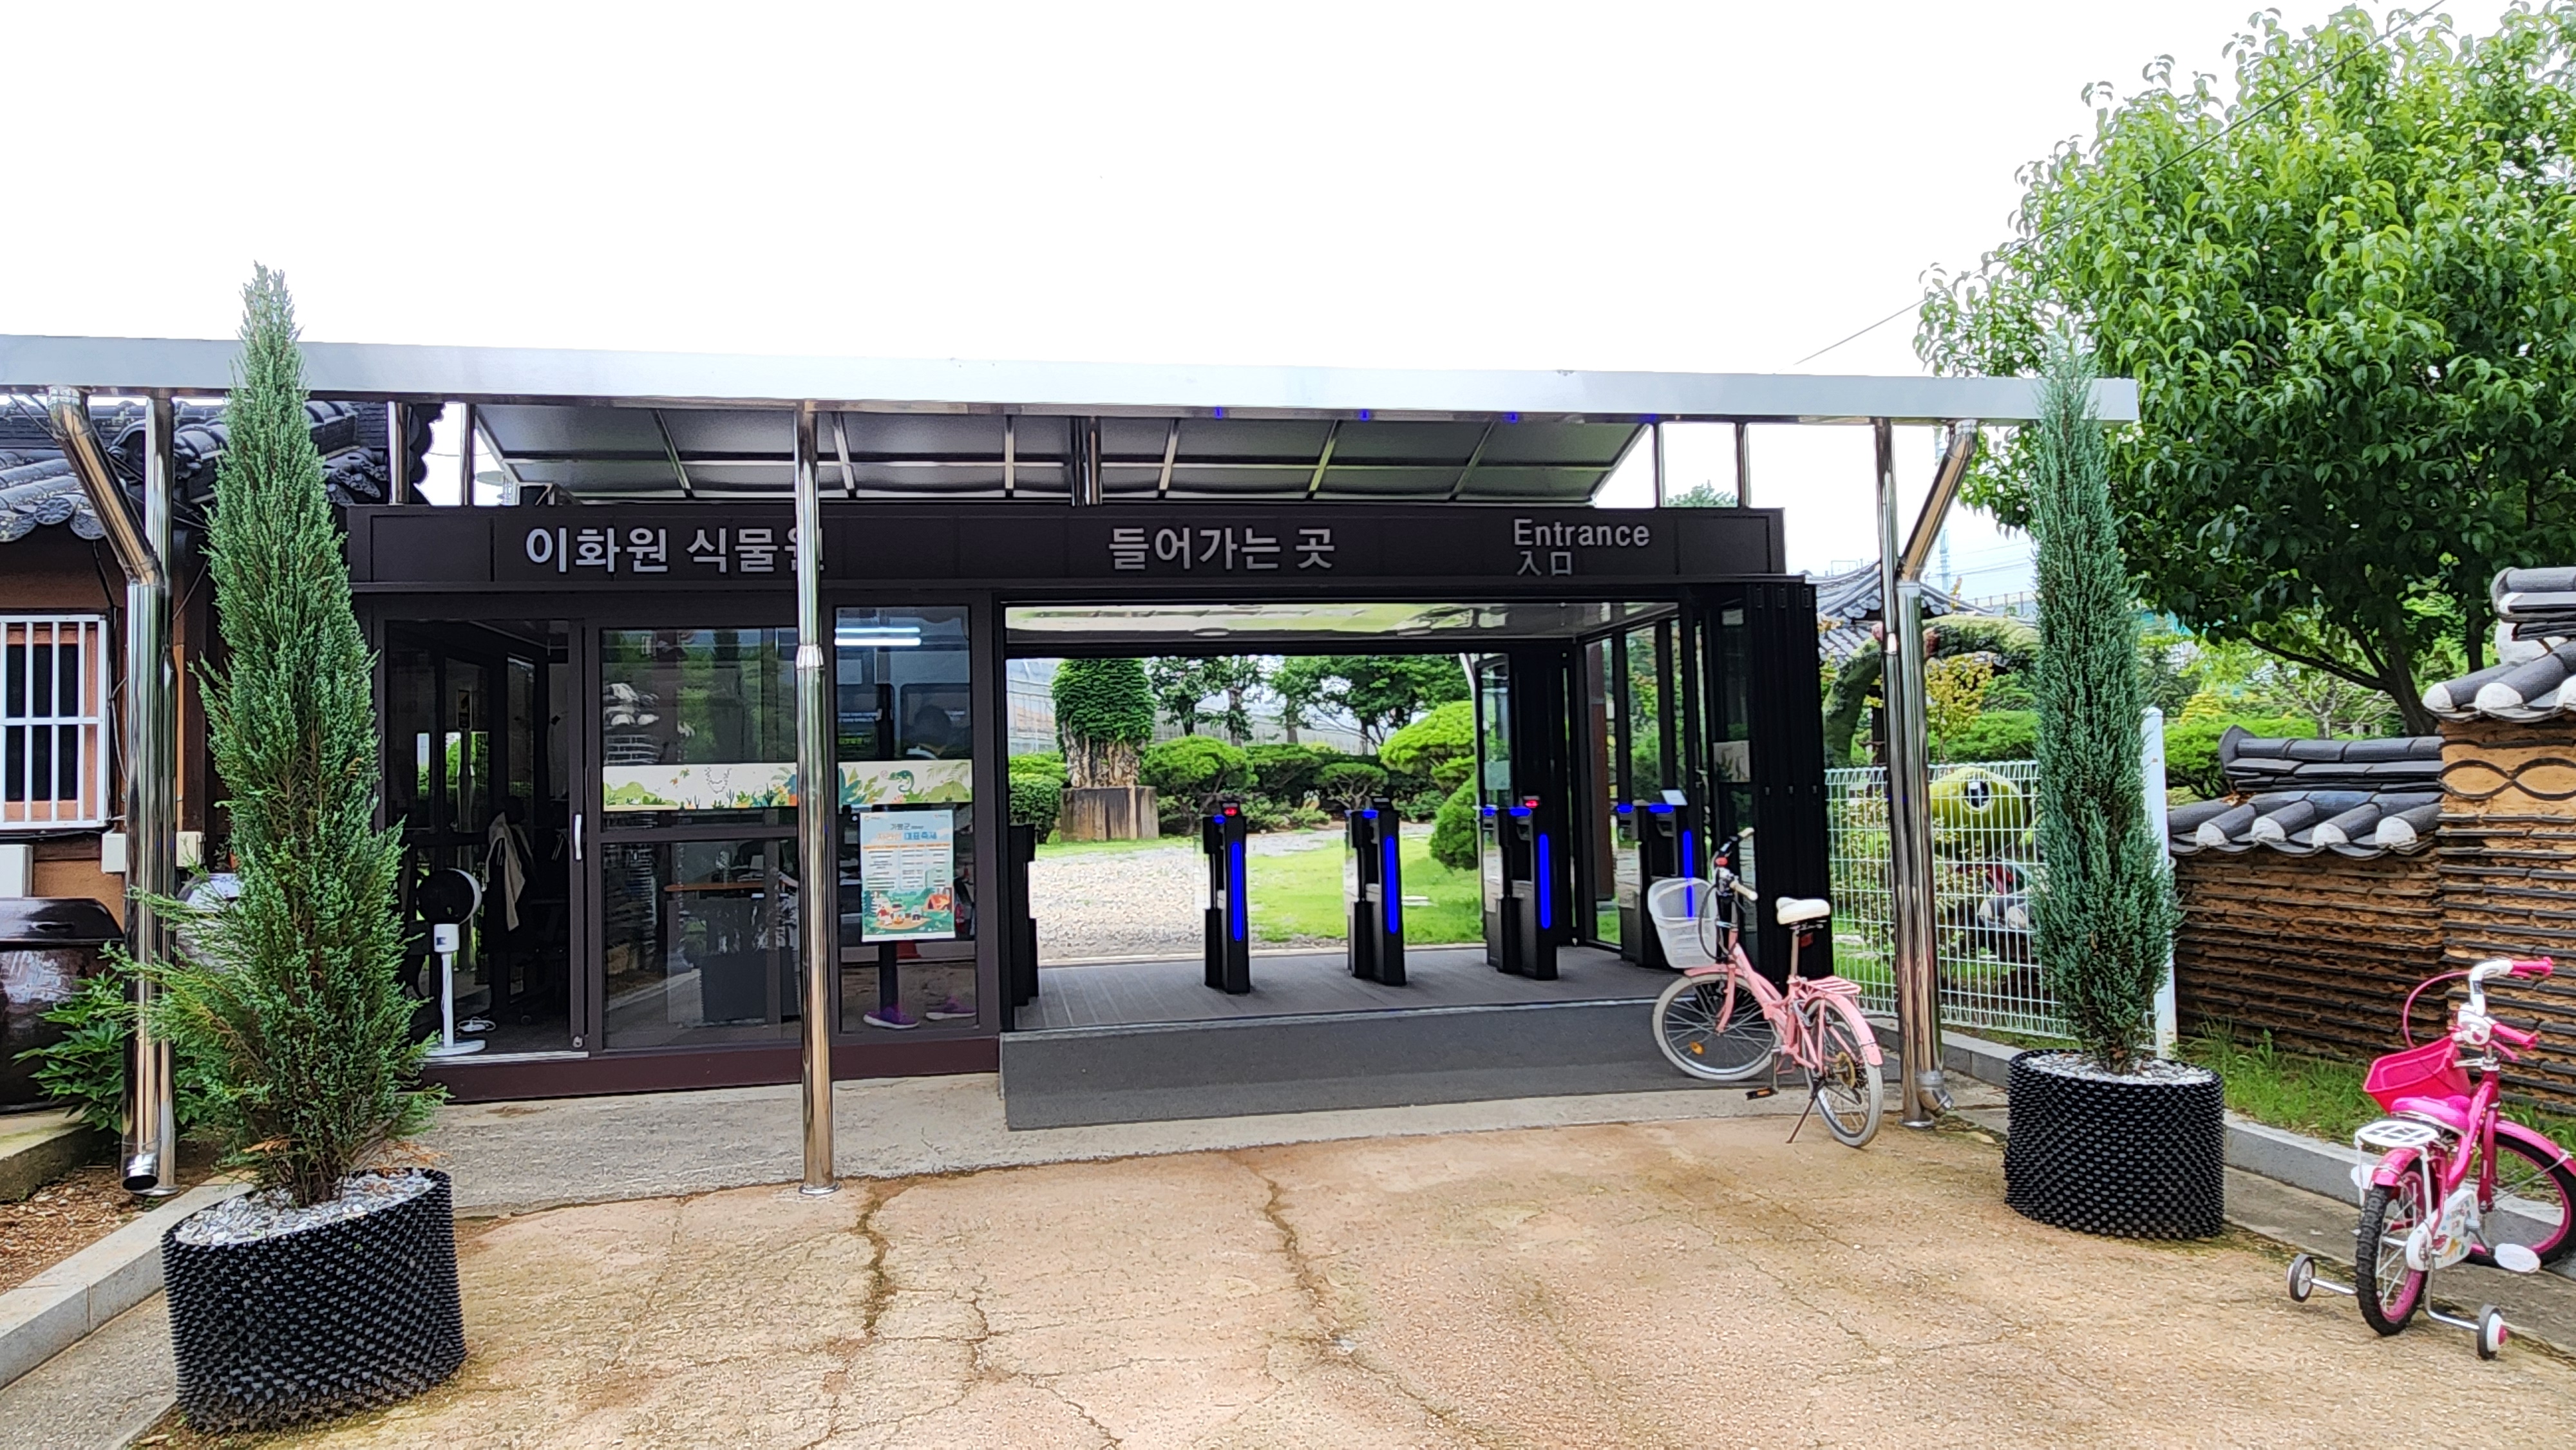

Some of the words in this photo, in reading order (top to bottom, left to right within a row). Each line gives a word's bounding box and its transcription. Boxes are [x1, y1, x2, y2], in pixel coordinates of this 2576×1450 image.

[526, 527, 668, 572] 이화원
[1108, 527, 1281, 569] 들어가는
[1296, 528, 1335, 569] 곳
[1514, 518, 1650, 546] Entrance
[1516, 551, 1573, 576] 入口
